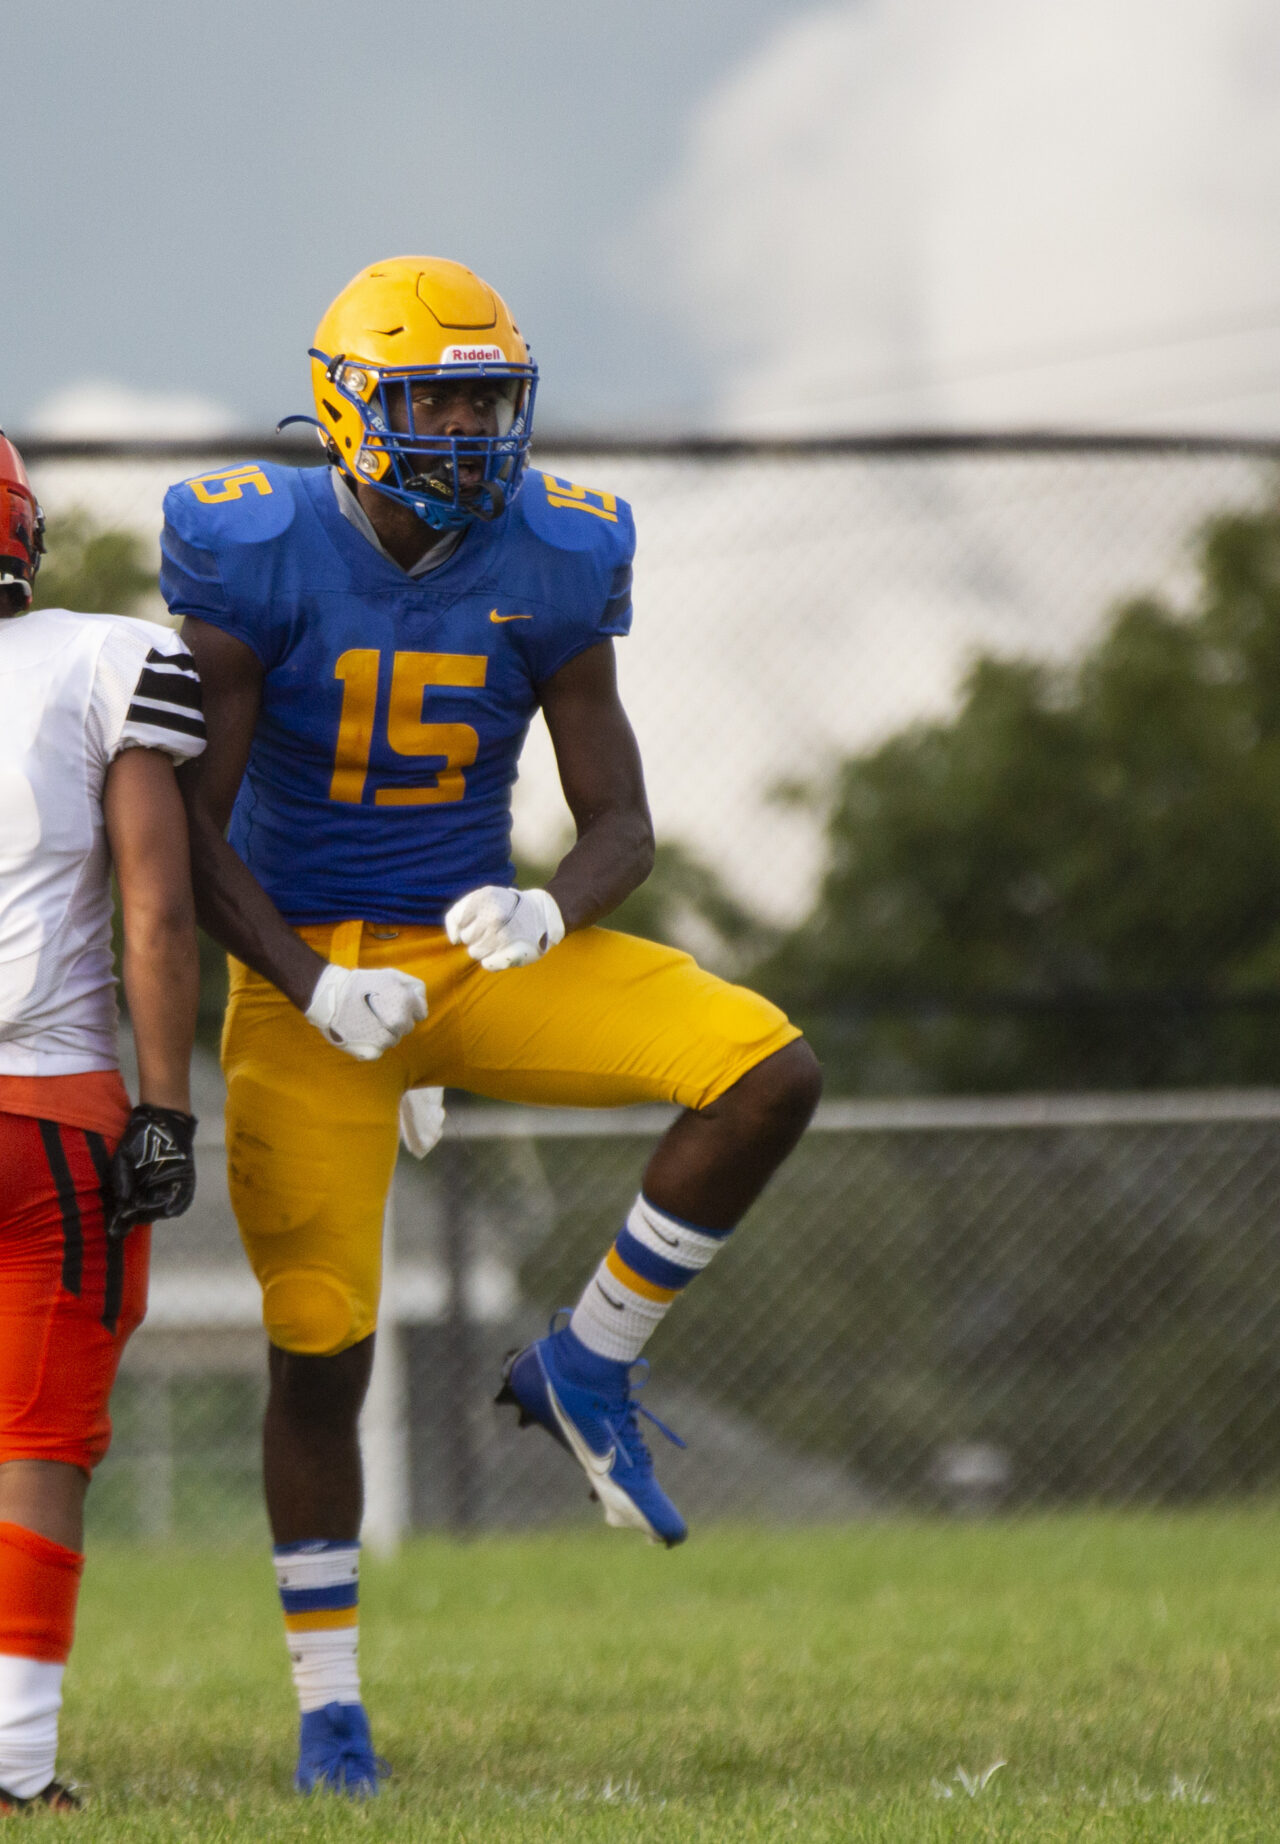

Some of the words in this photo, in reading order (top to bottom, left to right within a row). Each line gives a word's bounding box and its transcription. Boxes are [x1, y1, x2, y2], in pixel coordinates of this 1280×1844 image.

[452, 348, 501, 361] Riddell
[185, 465, 273, 504] 15
[542, 473, 618, 523] 15
[329, 648, 488, 806] 15
